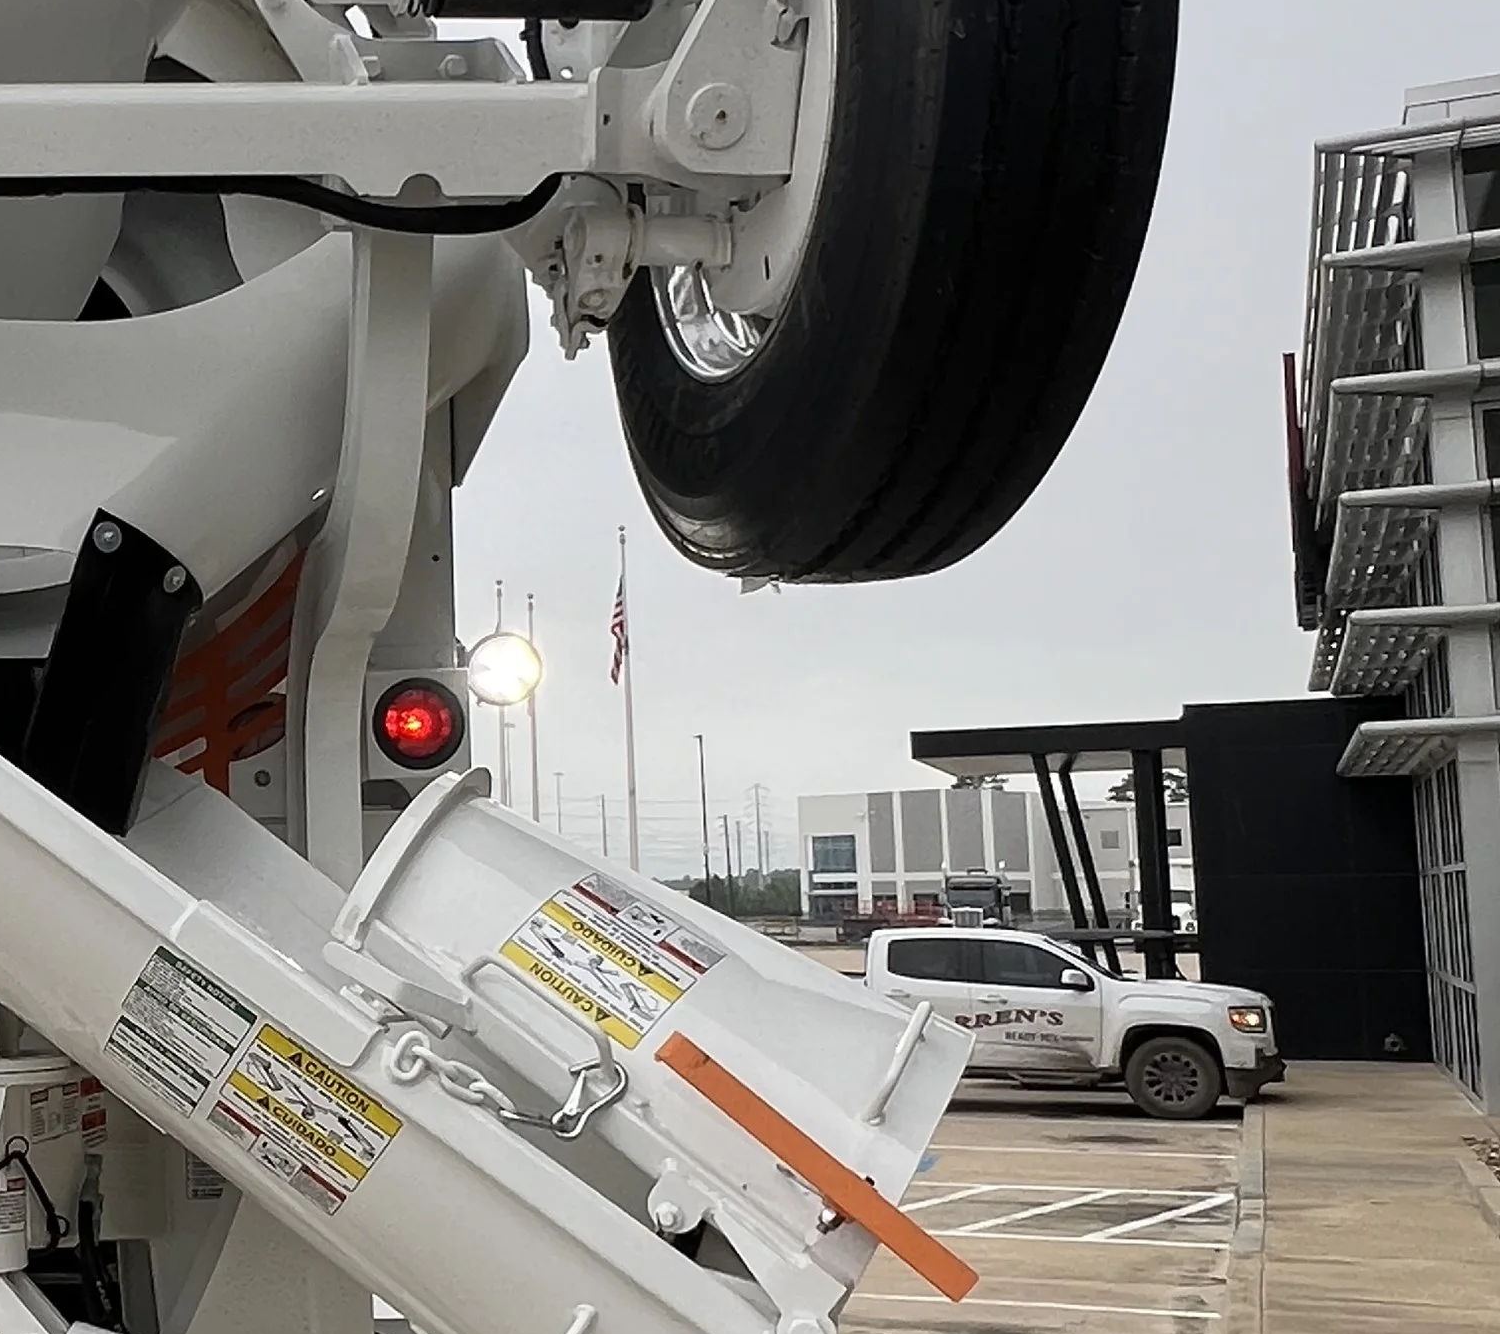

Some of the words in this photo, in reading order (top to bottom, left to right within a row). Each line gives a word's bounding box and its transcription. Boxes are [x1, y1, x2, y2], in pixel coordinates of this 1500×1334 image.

[571, 920, 637, 968] CUIDADO
[528, 962, 594, 1012] CAUTION
[305, 1061, 370, 1113] CAUTION
[272, 1106, 337, 1157] CUIDADO
